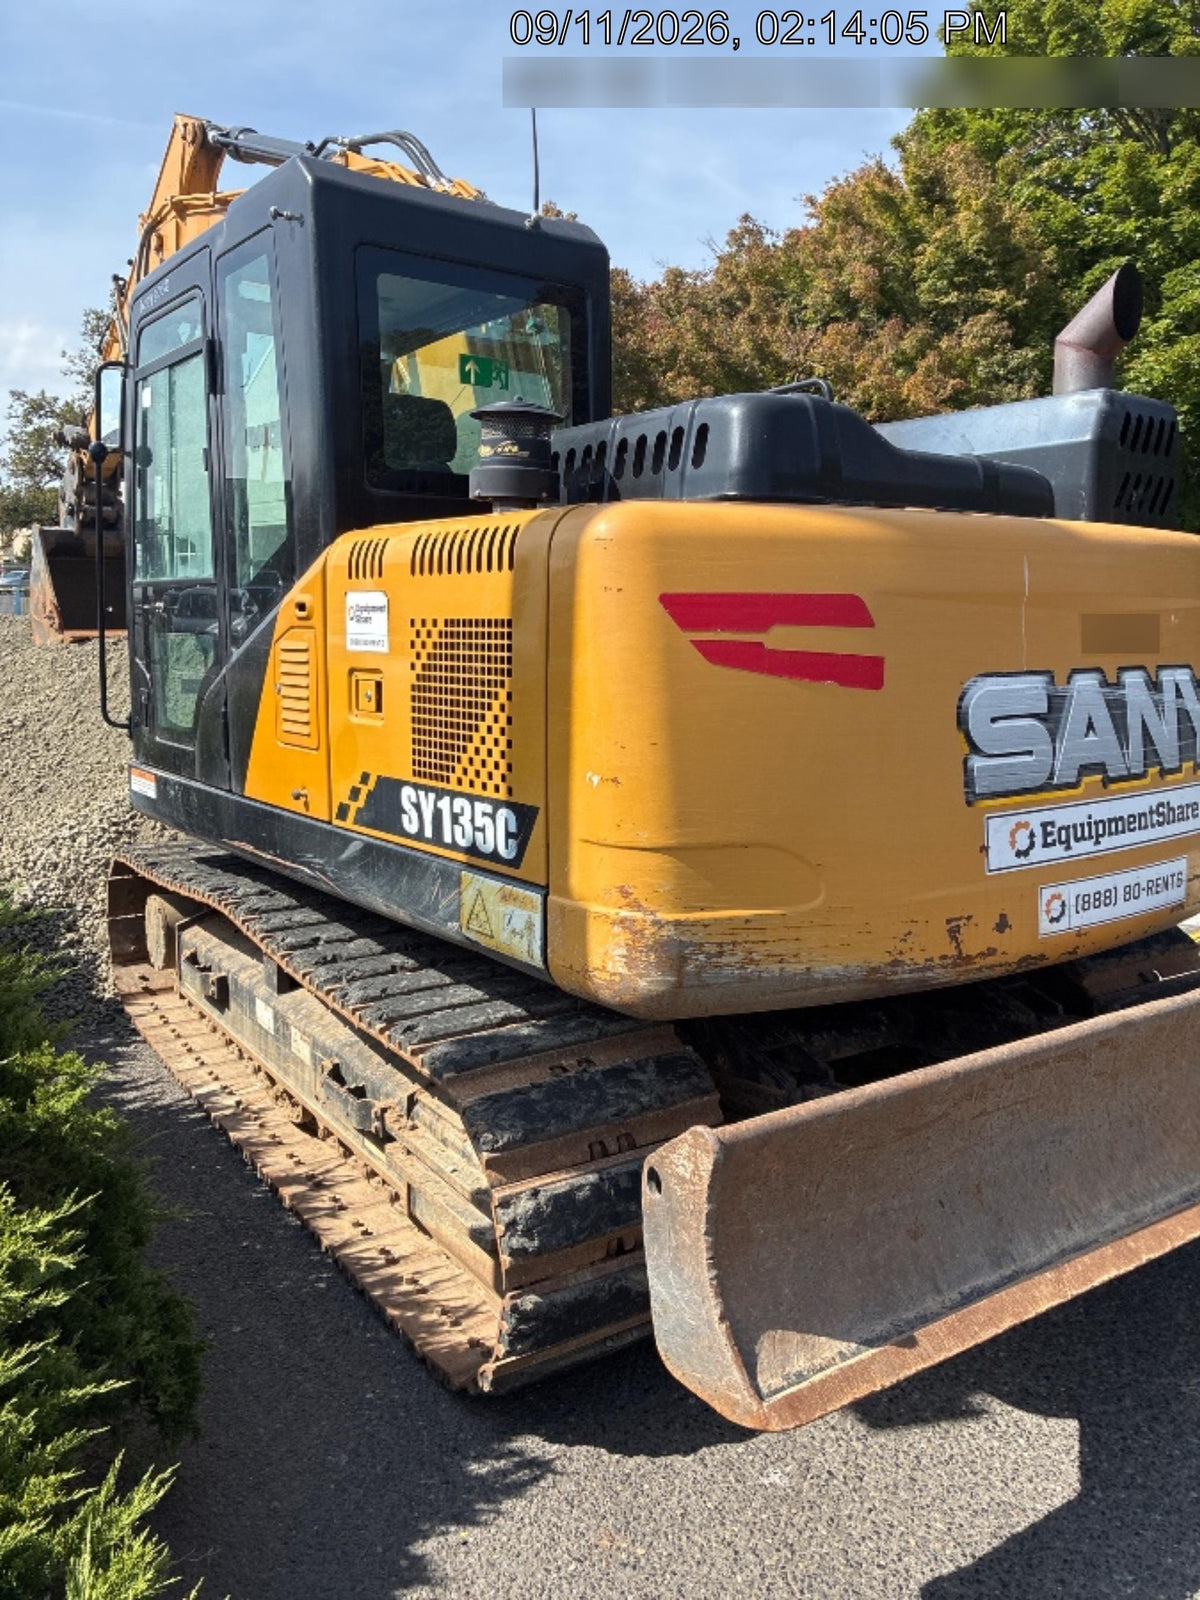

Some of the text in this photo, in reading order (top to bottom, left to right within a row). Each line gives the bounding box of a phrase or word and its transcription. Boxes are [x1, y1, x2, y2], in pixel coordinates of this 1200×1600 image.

[401, 785, 518, 860] SY135C
[1040, 800, 1200, 852] EquipmentShare
[1075, 870, 1184, 914] (888) 80-RENTS
